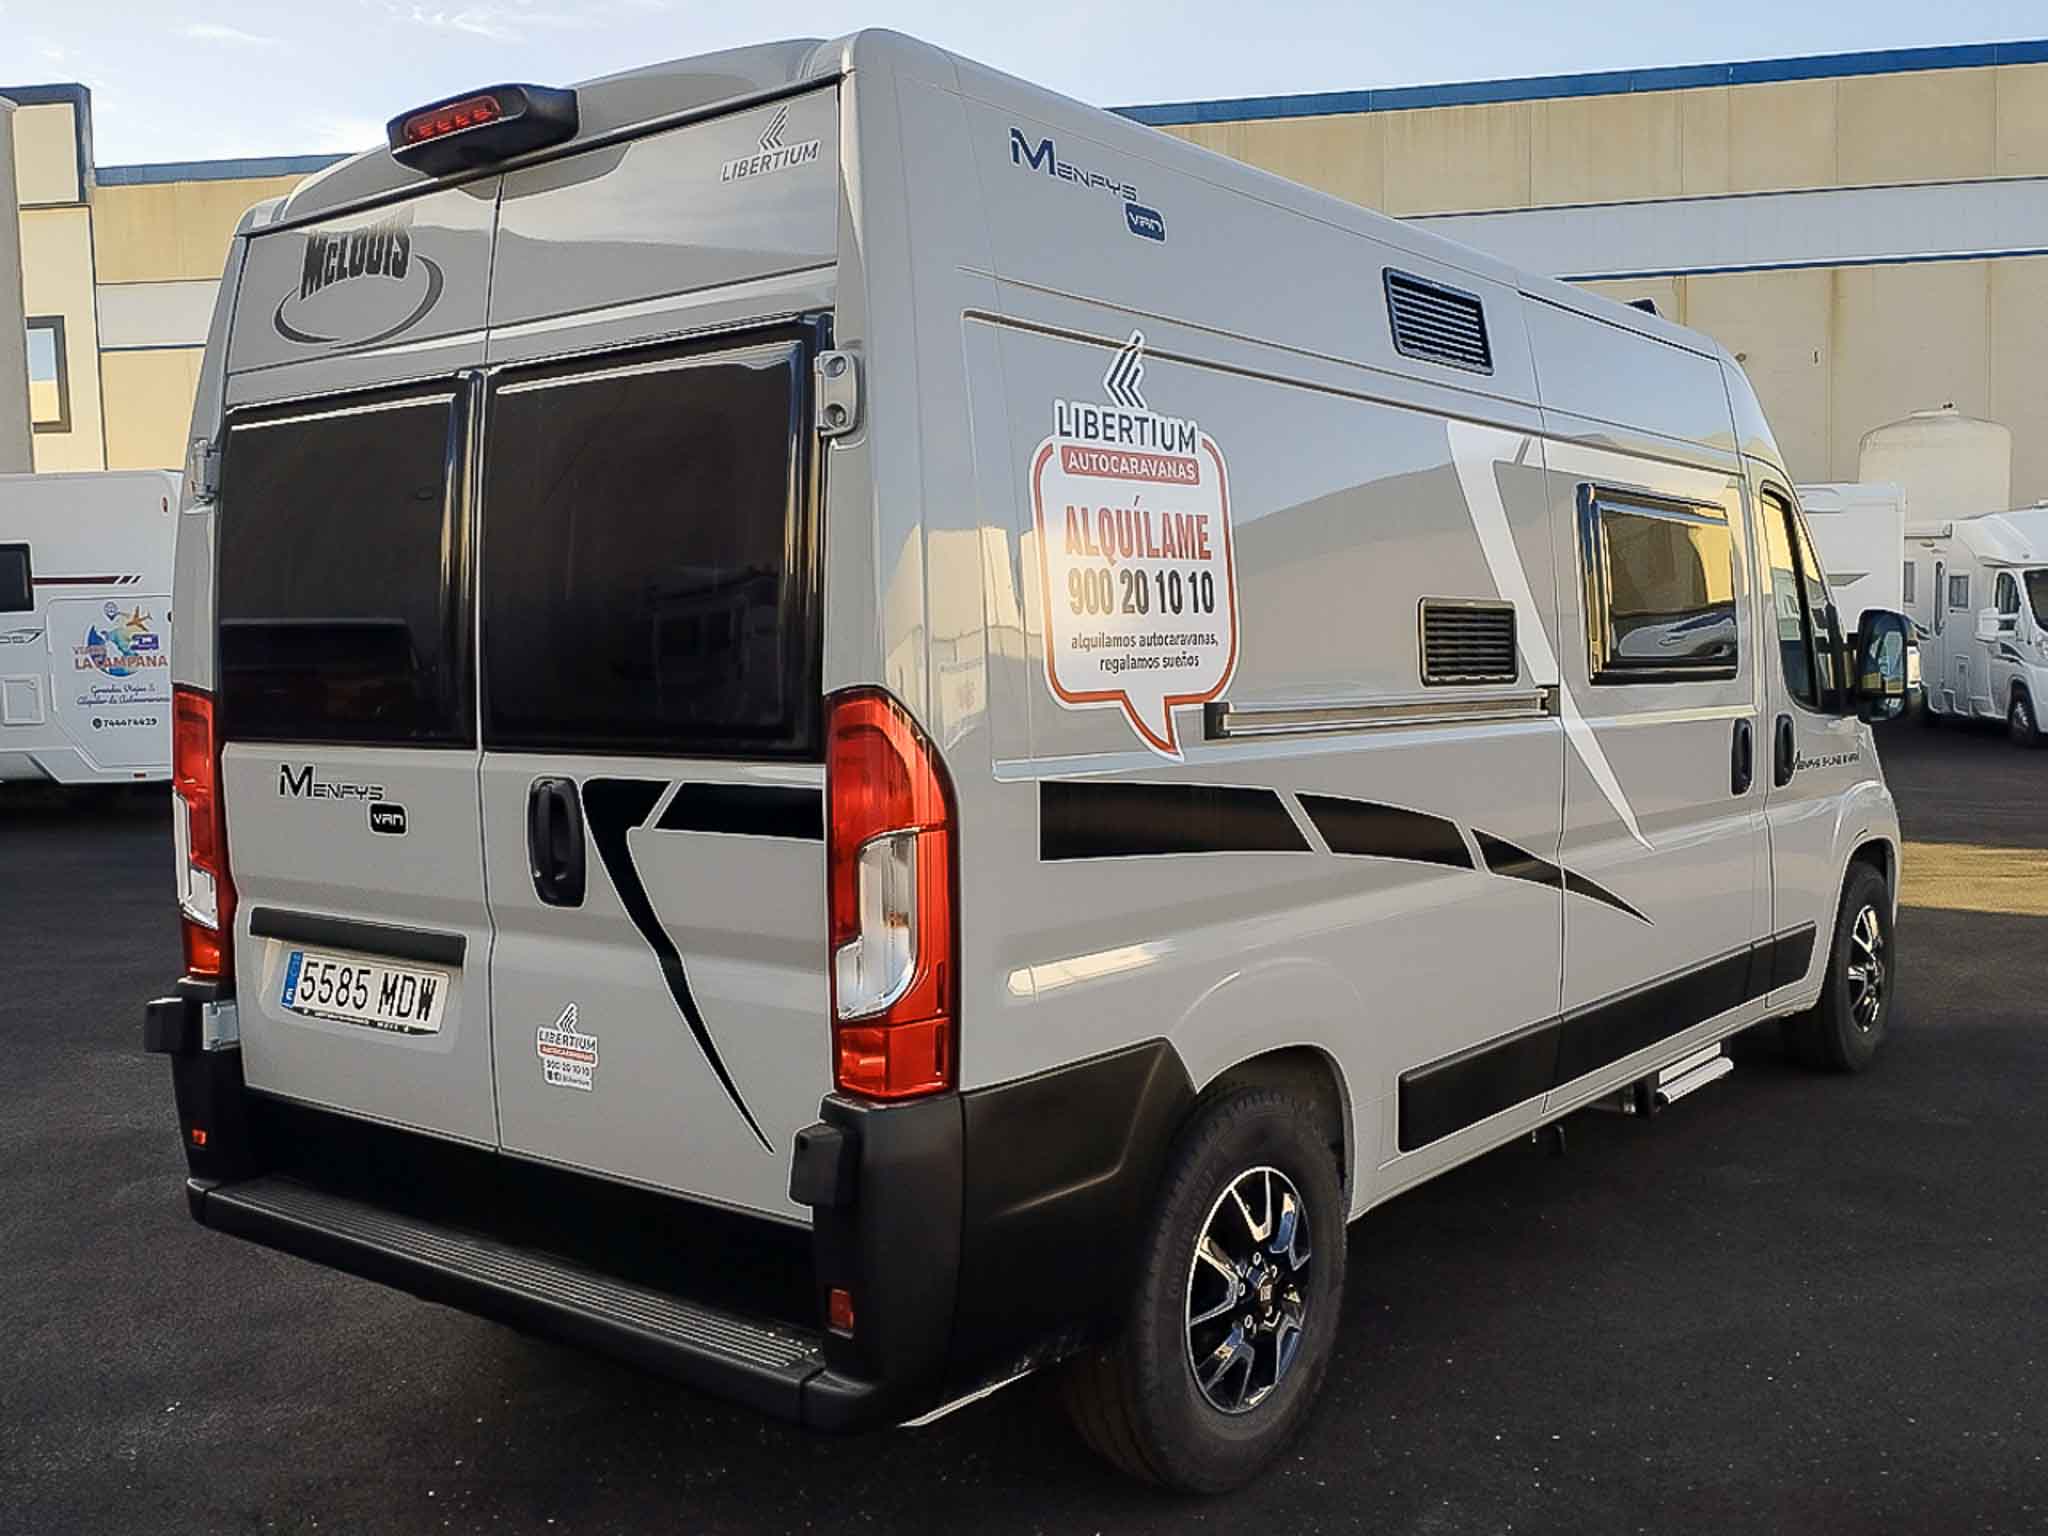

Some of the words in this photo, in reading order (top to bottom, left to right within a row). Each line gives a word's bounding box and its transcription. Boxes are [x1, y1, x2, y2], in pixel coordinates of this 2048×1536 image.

[722, 141, 819, 182] LIBERTIUM
[1057, 405, 1197, 454] LIBERTIUM
[1067, 451, 1197, 480] AUTOCARAVANAS
[1064, 495, 1212, 566] ALQUÍLAME
[1068, 567, 1114, 615] 900
[1119, 568, 1149, 615] 20
[1155, 569, 1183, 615] 10
[1188, 570, 1215, 614] 10
[1071, 631, 1137, 652] alquilamos
[1138, 631, 1219, 647] autocaravanas,
[1099, 653, 1160, 674] regalamos
[1162, 650, 1200, 669] sueños
[300, 961, 371, 1010] 5585
[377, 972, 437, 1022] MDW
[539, 1030, 596, 1051] LIBERTIUM
